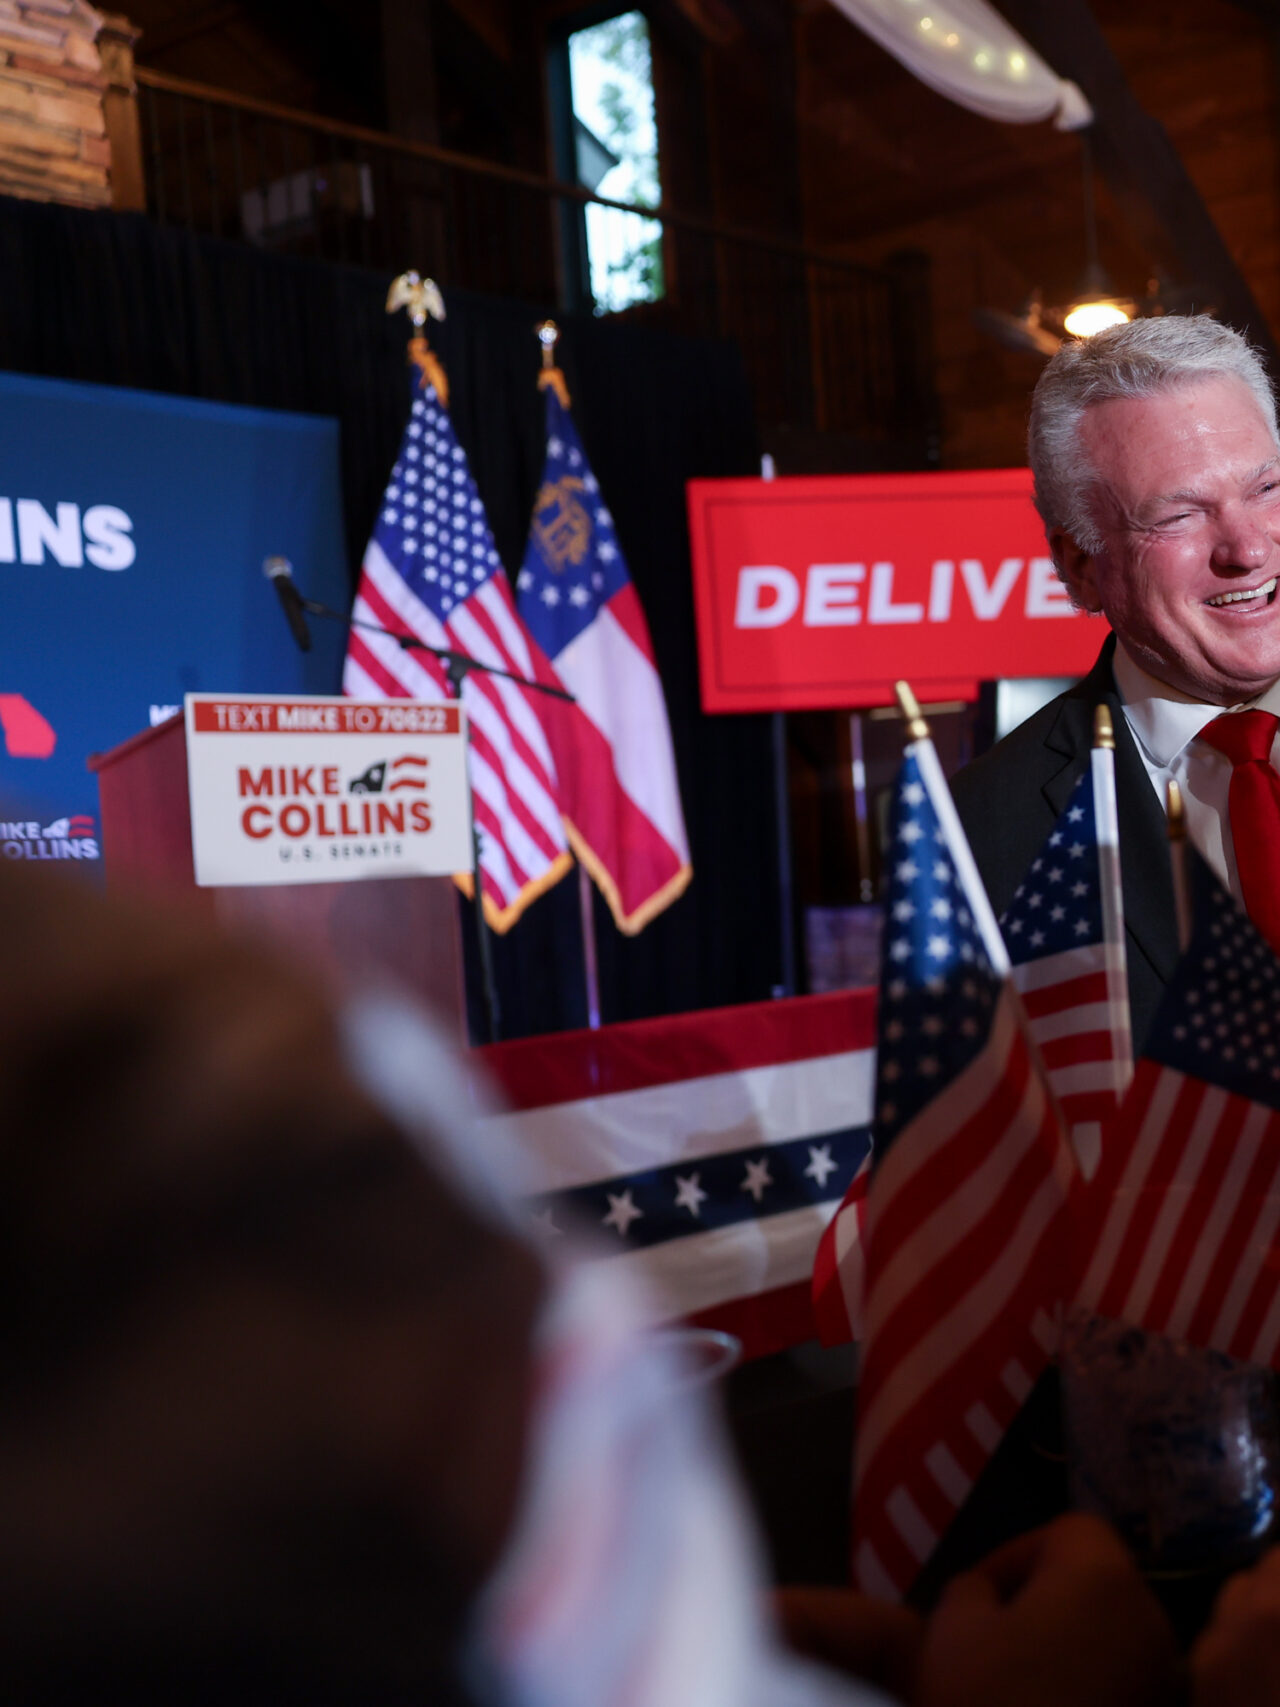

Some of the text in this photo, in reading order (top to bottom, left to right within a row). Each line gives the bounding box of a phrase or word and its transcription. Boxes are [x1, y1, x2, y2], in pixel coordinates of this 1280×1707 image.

[213, 704, 273, 729] TEXT
[277, 705, 340, 731] MIKE
[343, 707, 376, 731] TO
[237, 765, 340, 798] MIKE
[241, 800, 433, 839] COLLINS
[330, 840, 404, 860] SENATE
